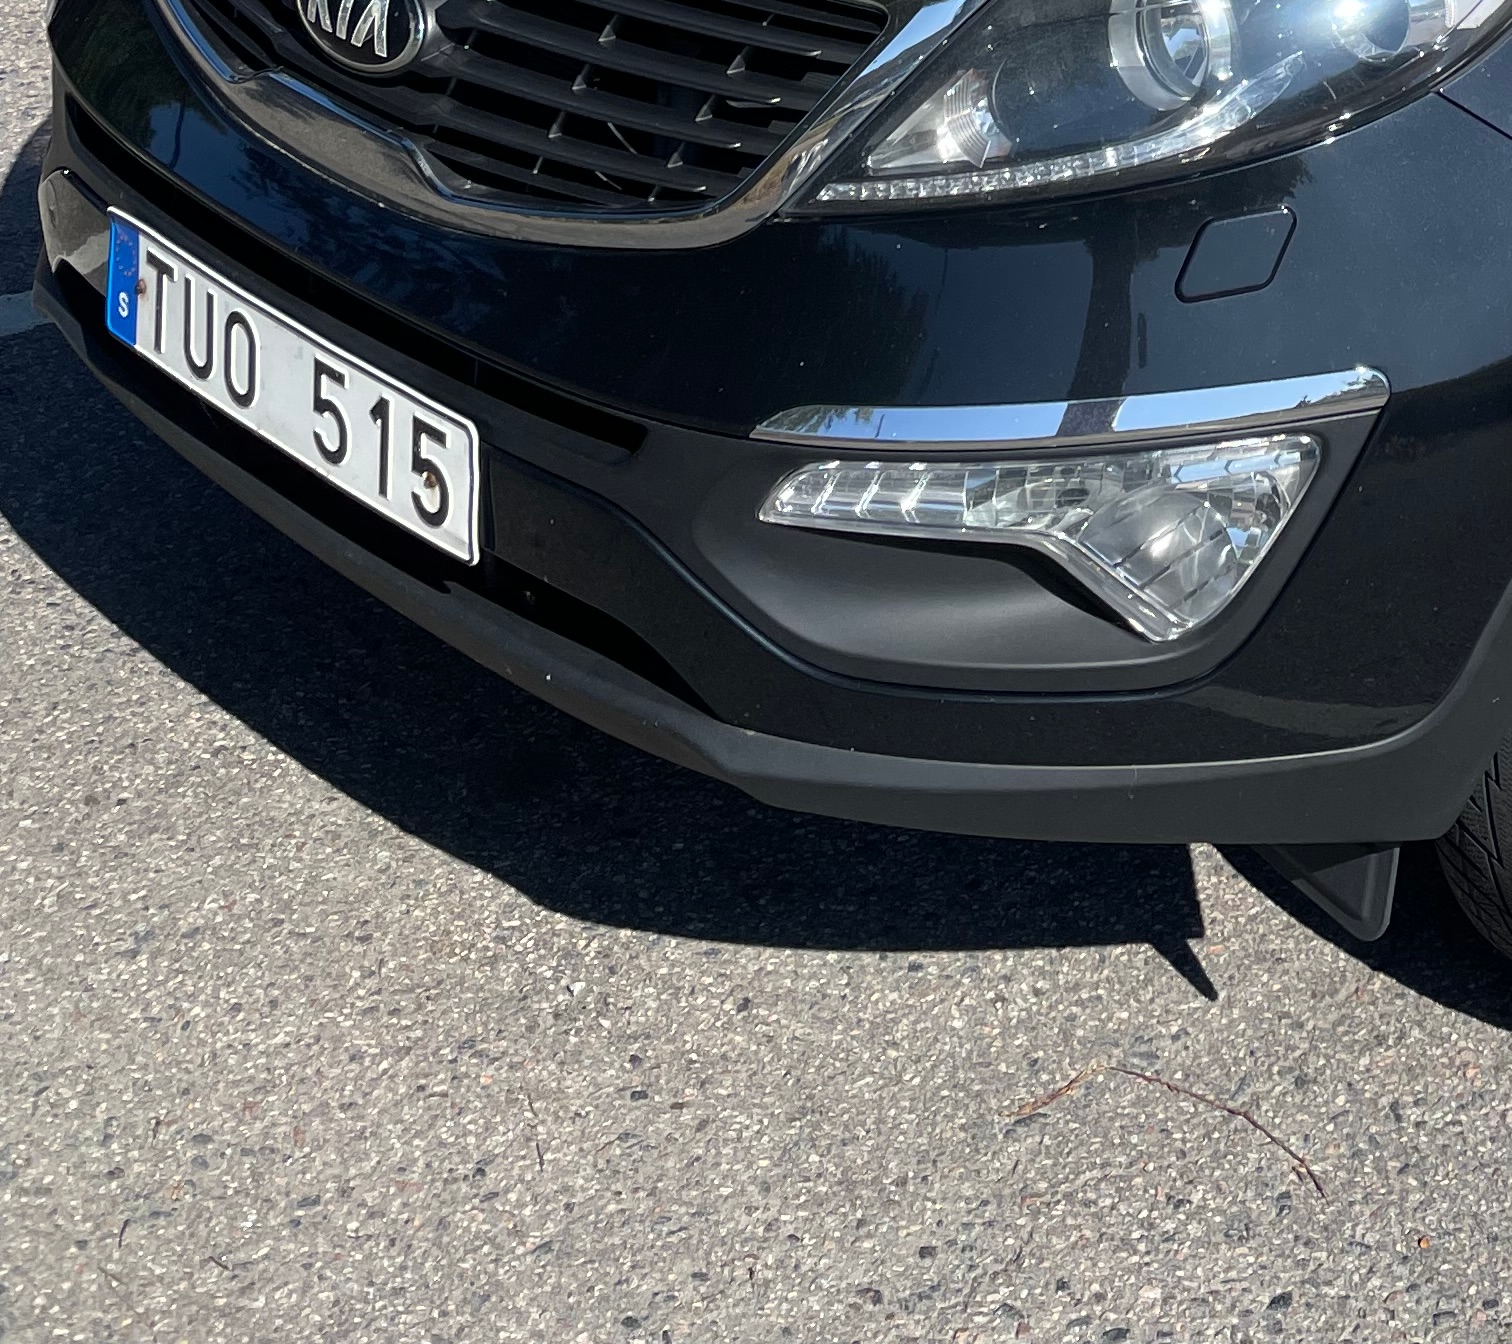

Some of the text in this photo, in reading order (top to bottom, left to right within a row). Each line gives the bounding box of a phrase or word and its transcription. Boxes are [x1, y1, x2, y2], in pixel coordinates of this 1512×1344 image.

[117, 291, 130, 319] S
[146, 247, 453, 529] TUO 515
